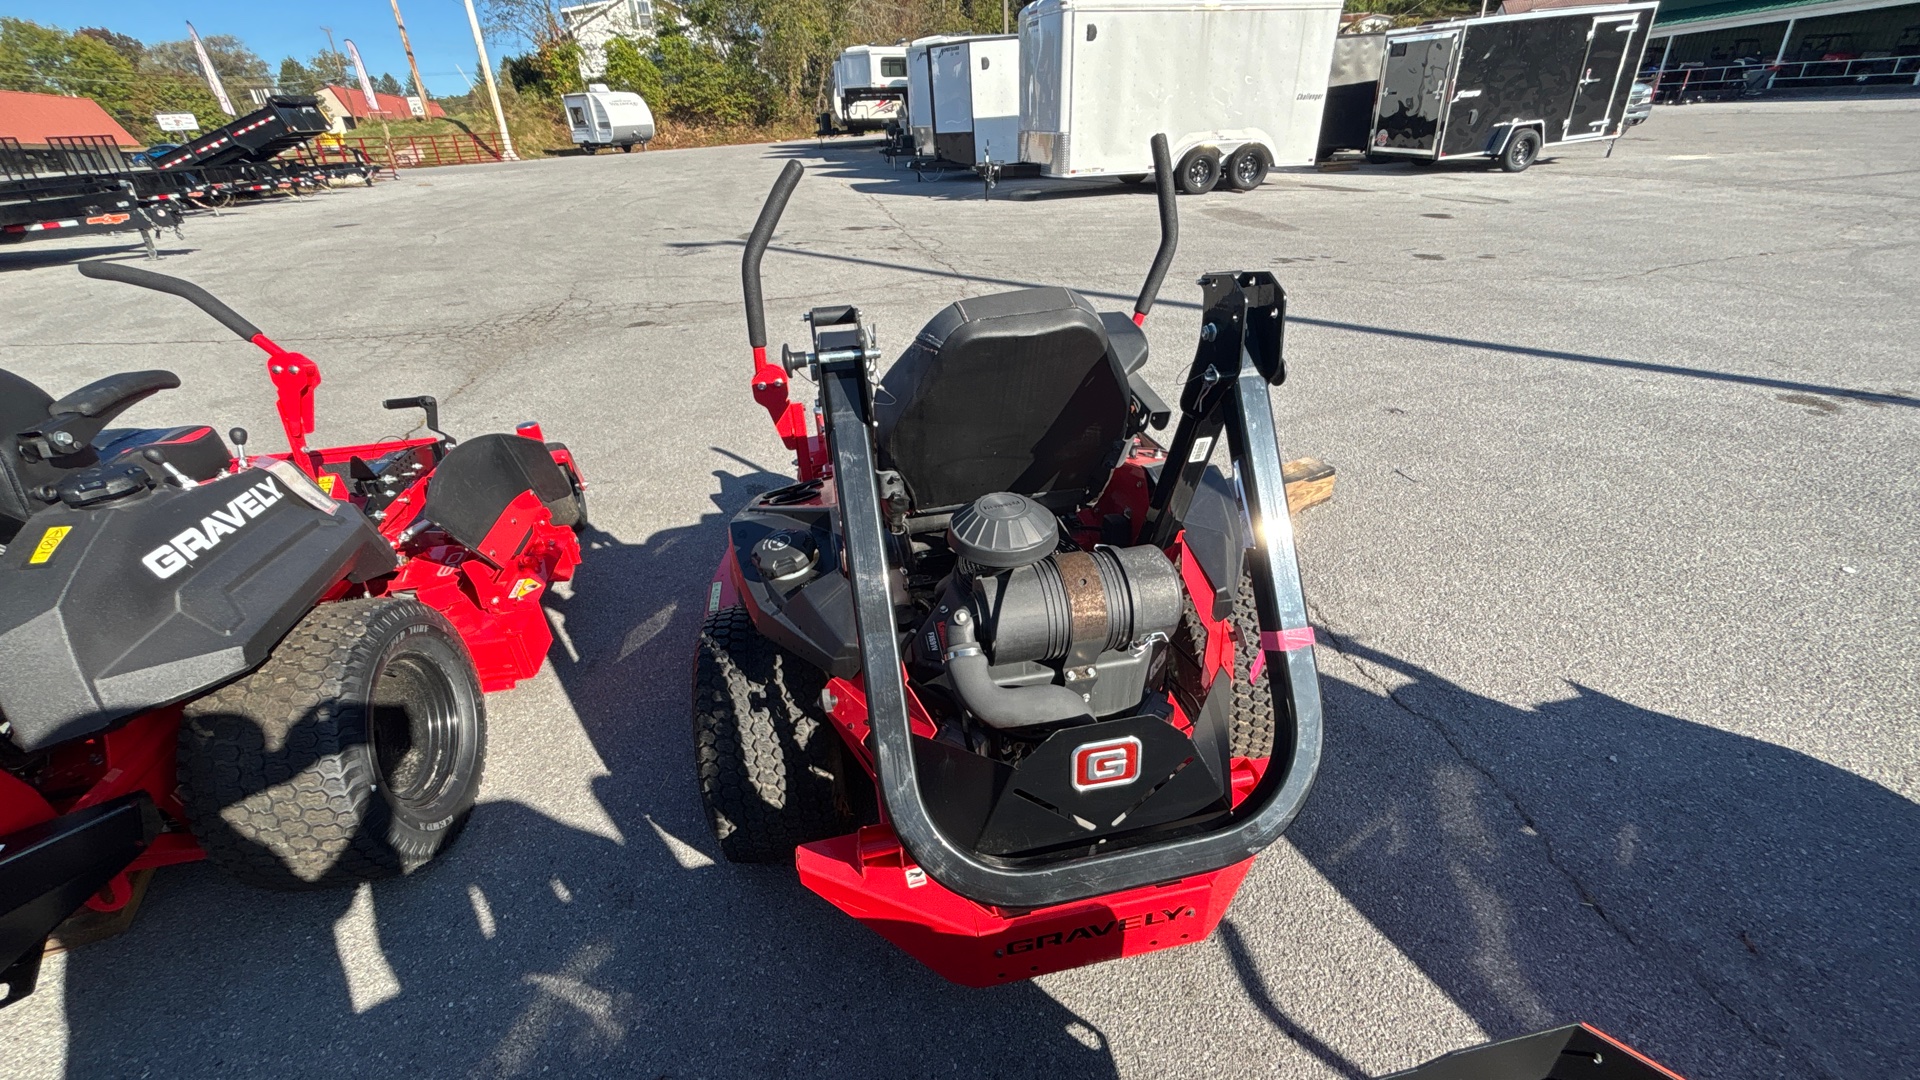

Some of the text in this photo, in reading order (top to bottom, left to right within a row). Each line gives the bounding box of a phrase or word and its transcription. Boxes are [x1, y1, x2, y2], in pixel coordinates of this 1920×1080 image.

[1296, 93, 1323, 101] Challenger
[142, 476, 283, 579] GRAVELY
[408, 624, 429, 635] TURF
[418, 814, 454, 831] KENDA
[1006, 905, 1188, 956] GRAVELY
